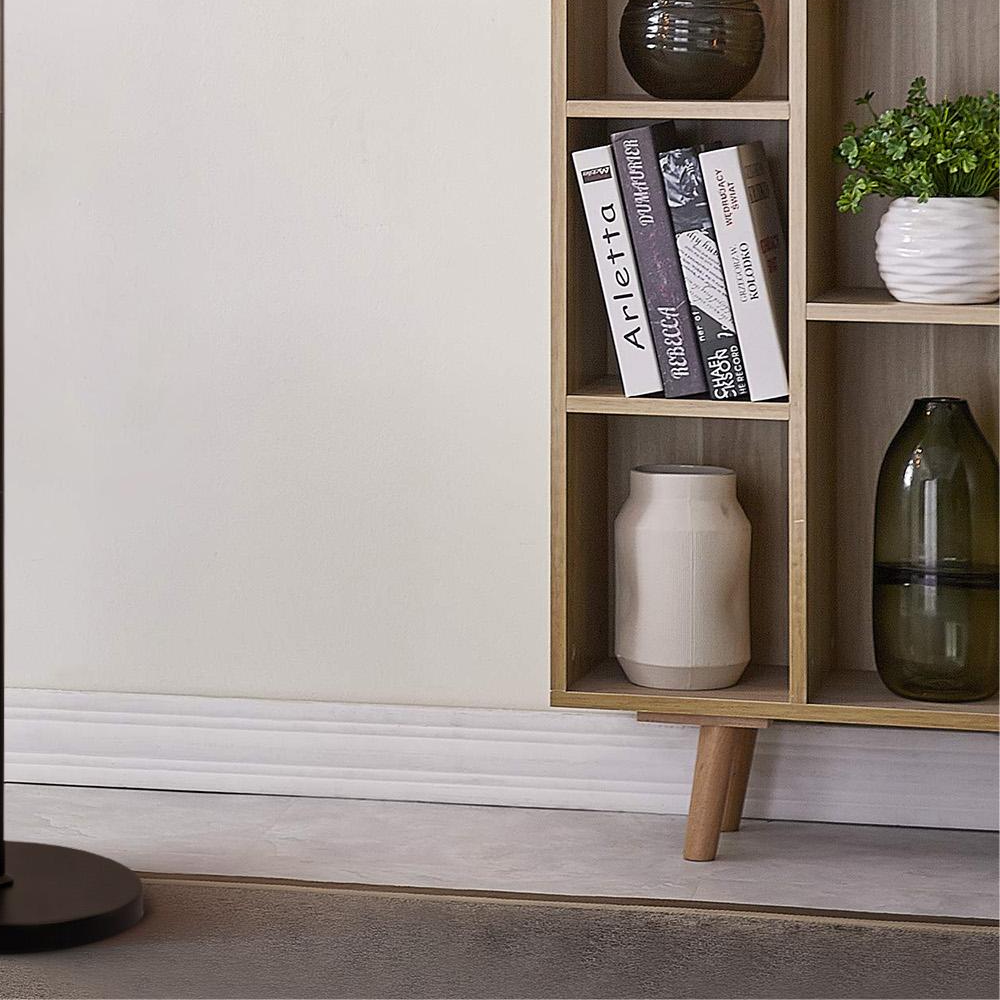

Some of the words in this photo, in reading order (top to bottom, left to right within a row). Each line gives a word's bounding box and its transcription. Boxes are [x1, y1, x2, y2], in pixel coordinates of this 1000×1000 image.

[601, 203, 645, 350] Arletta
[657, 306, 690, 380] REBECCA
[730, 345, 745, 382] RECORD
